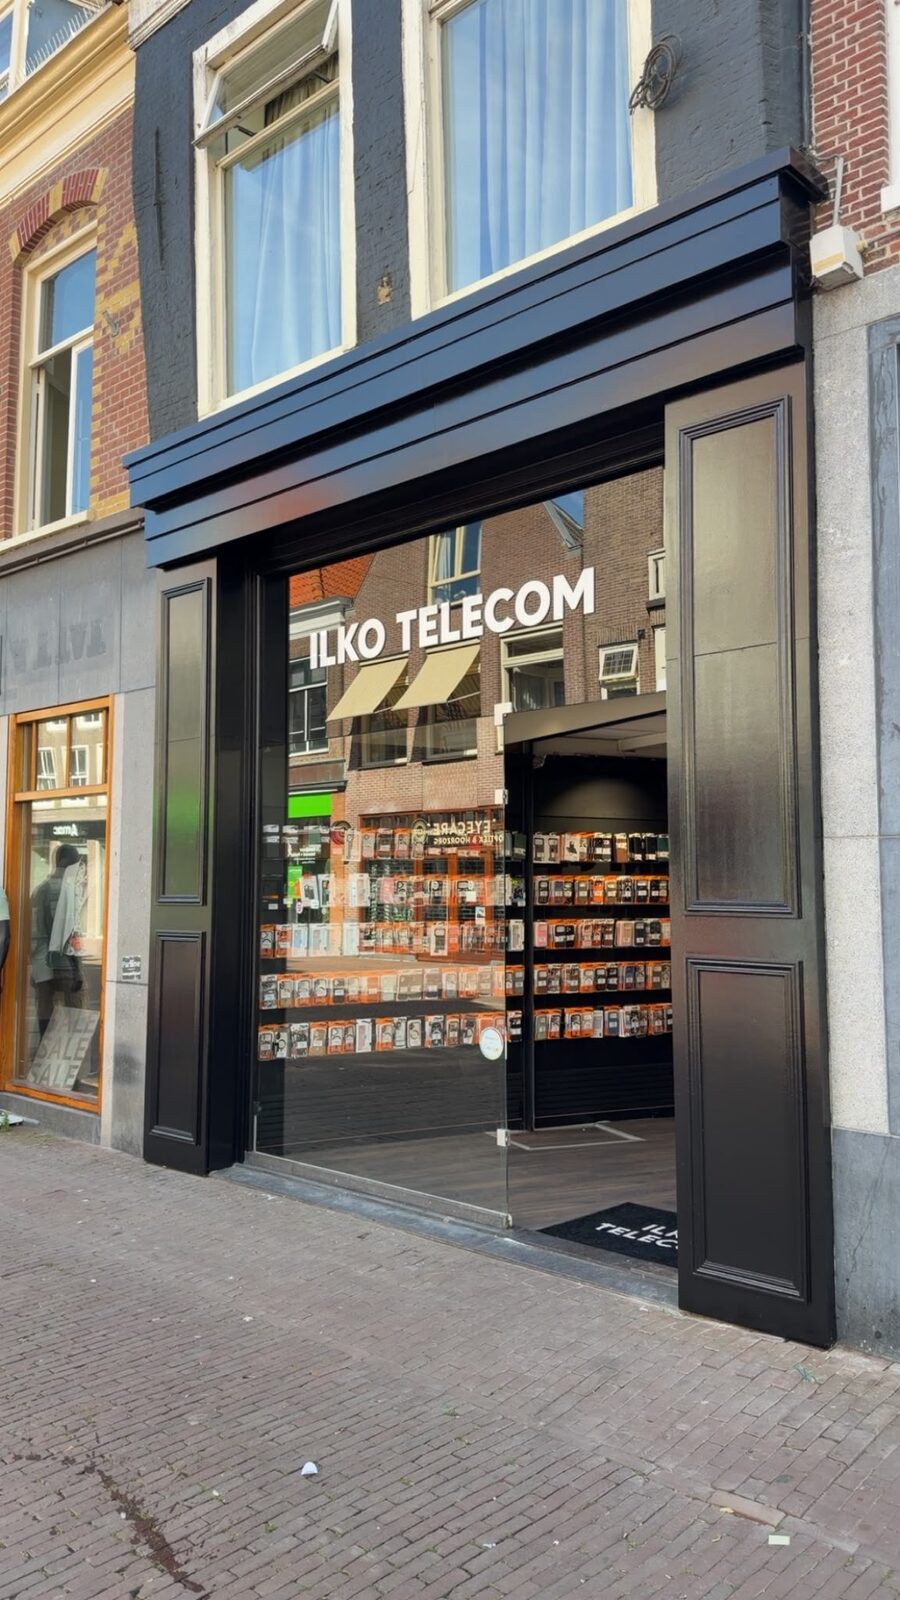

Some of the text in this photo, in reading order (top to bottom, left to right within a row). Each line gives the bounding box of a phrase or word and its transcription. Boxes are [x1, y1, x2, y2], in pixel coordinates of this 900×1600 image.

[309, 567, 595, 670] ILKO TELECOM
[36, 1036, 89, 1060] SALE
[31, 1063, 79, 1088] SALE
[595, 1222, 678, 1249] TELEC
